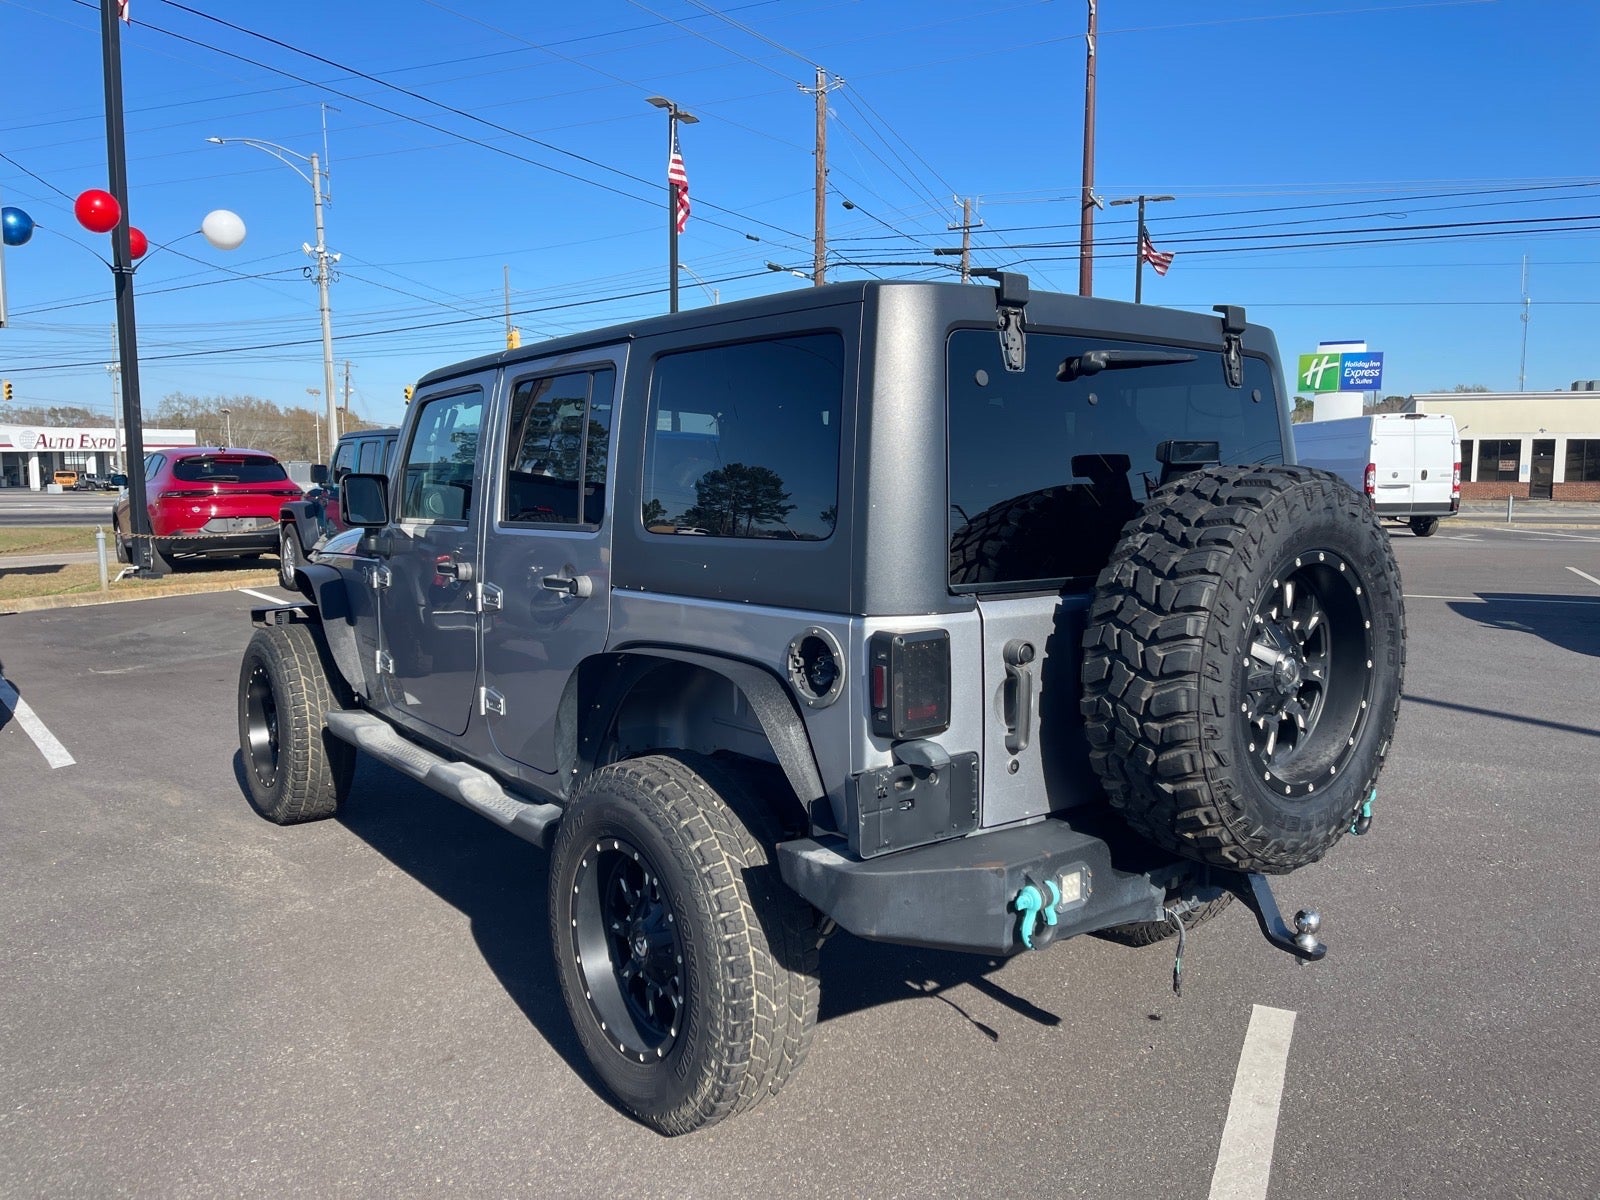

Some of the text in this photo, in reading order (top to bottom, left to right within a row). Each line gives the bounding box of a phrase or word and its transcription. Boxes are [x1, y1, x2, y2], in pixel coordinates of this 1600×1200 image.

[1345, 360, 1381, 368] Holiday Inn
[1344, 368, 1380, 378] Express
[34, 433, 117, 450] AUTO EXPO
[674, 890, 701, 1081] YOKOHAMA
